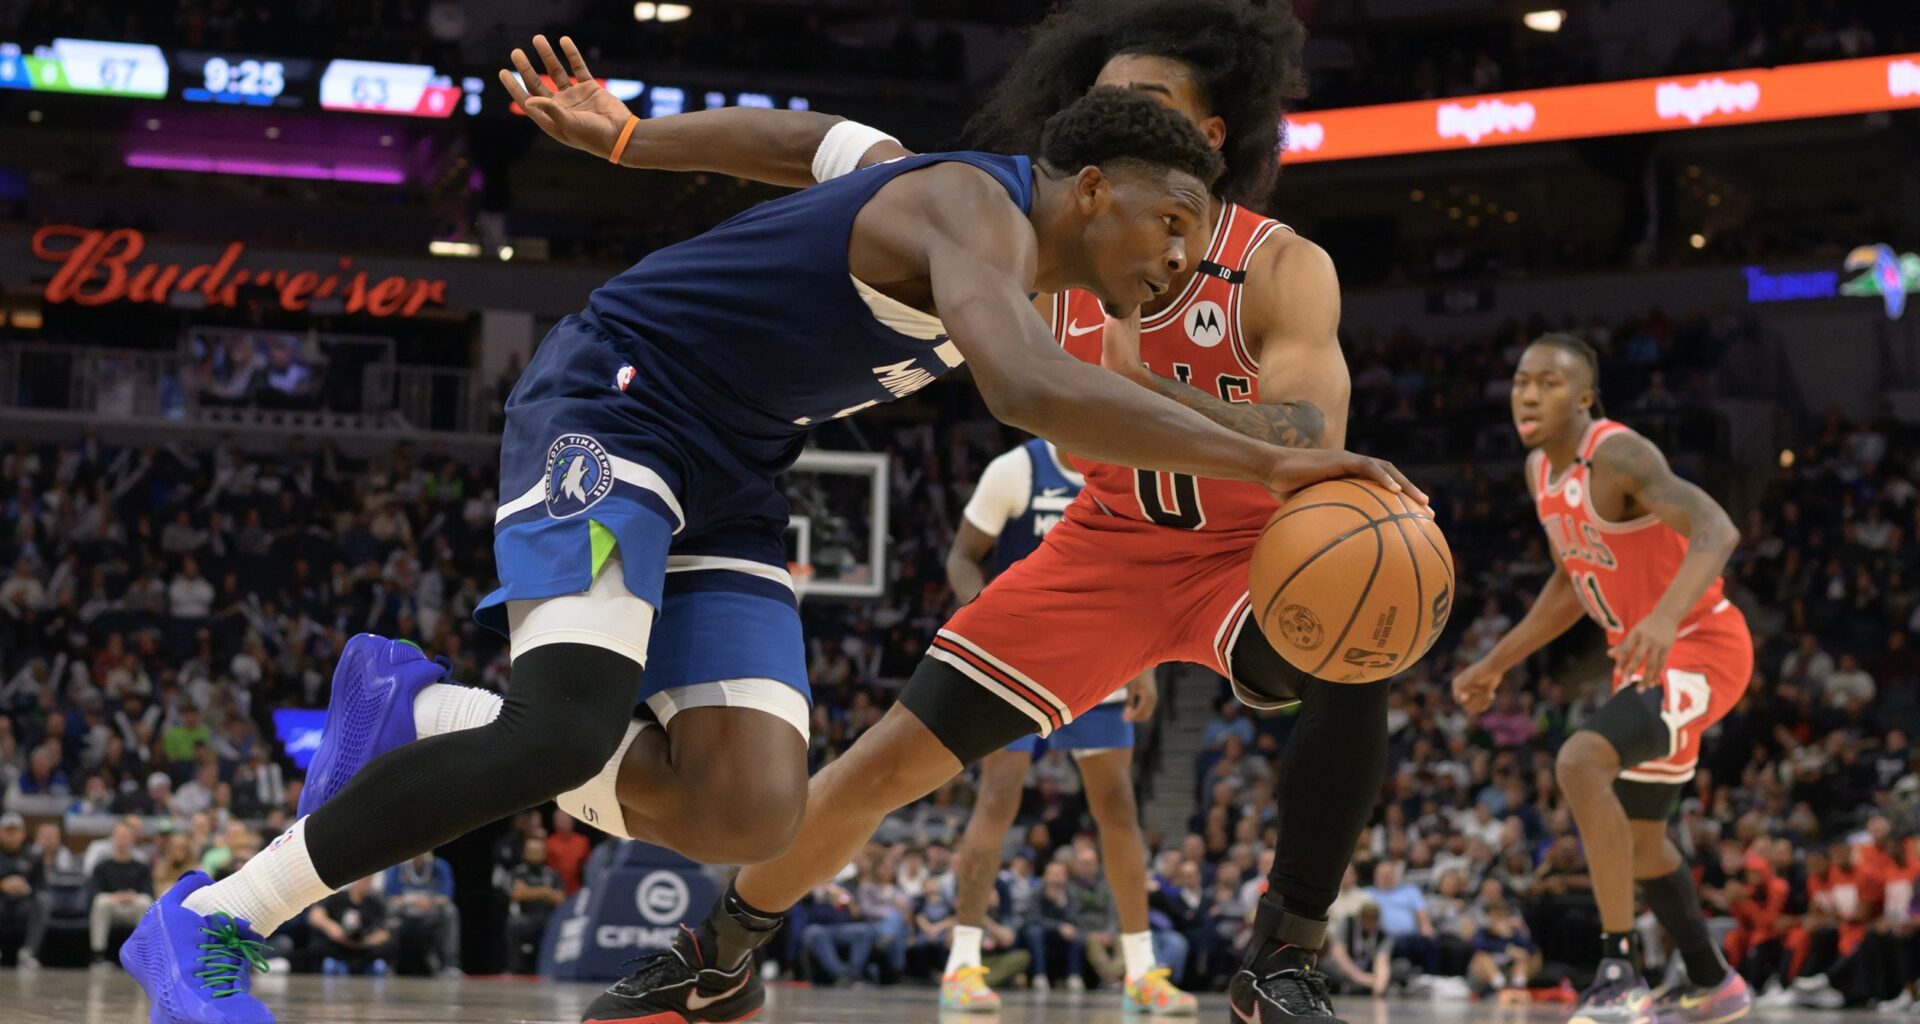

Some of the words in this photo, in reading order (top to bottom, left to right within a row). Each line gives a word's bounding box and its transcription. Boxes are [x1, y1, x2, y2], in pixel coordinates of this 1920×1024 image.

[100, 57, 139, 85] 67
[204, 57, 284, 97] 9:25
[31, 225, 446, 315] Budweiser
[1218, 266, 1231, 280] 10
[568, 436, 611, 497] TIMBERWOLVES
